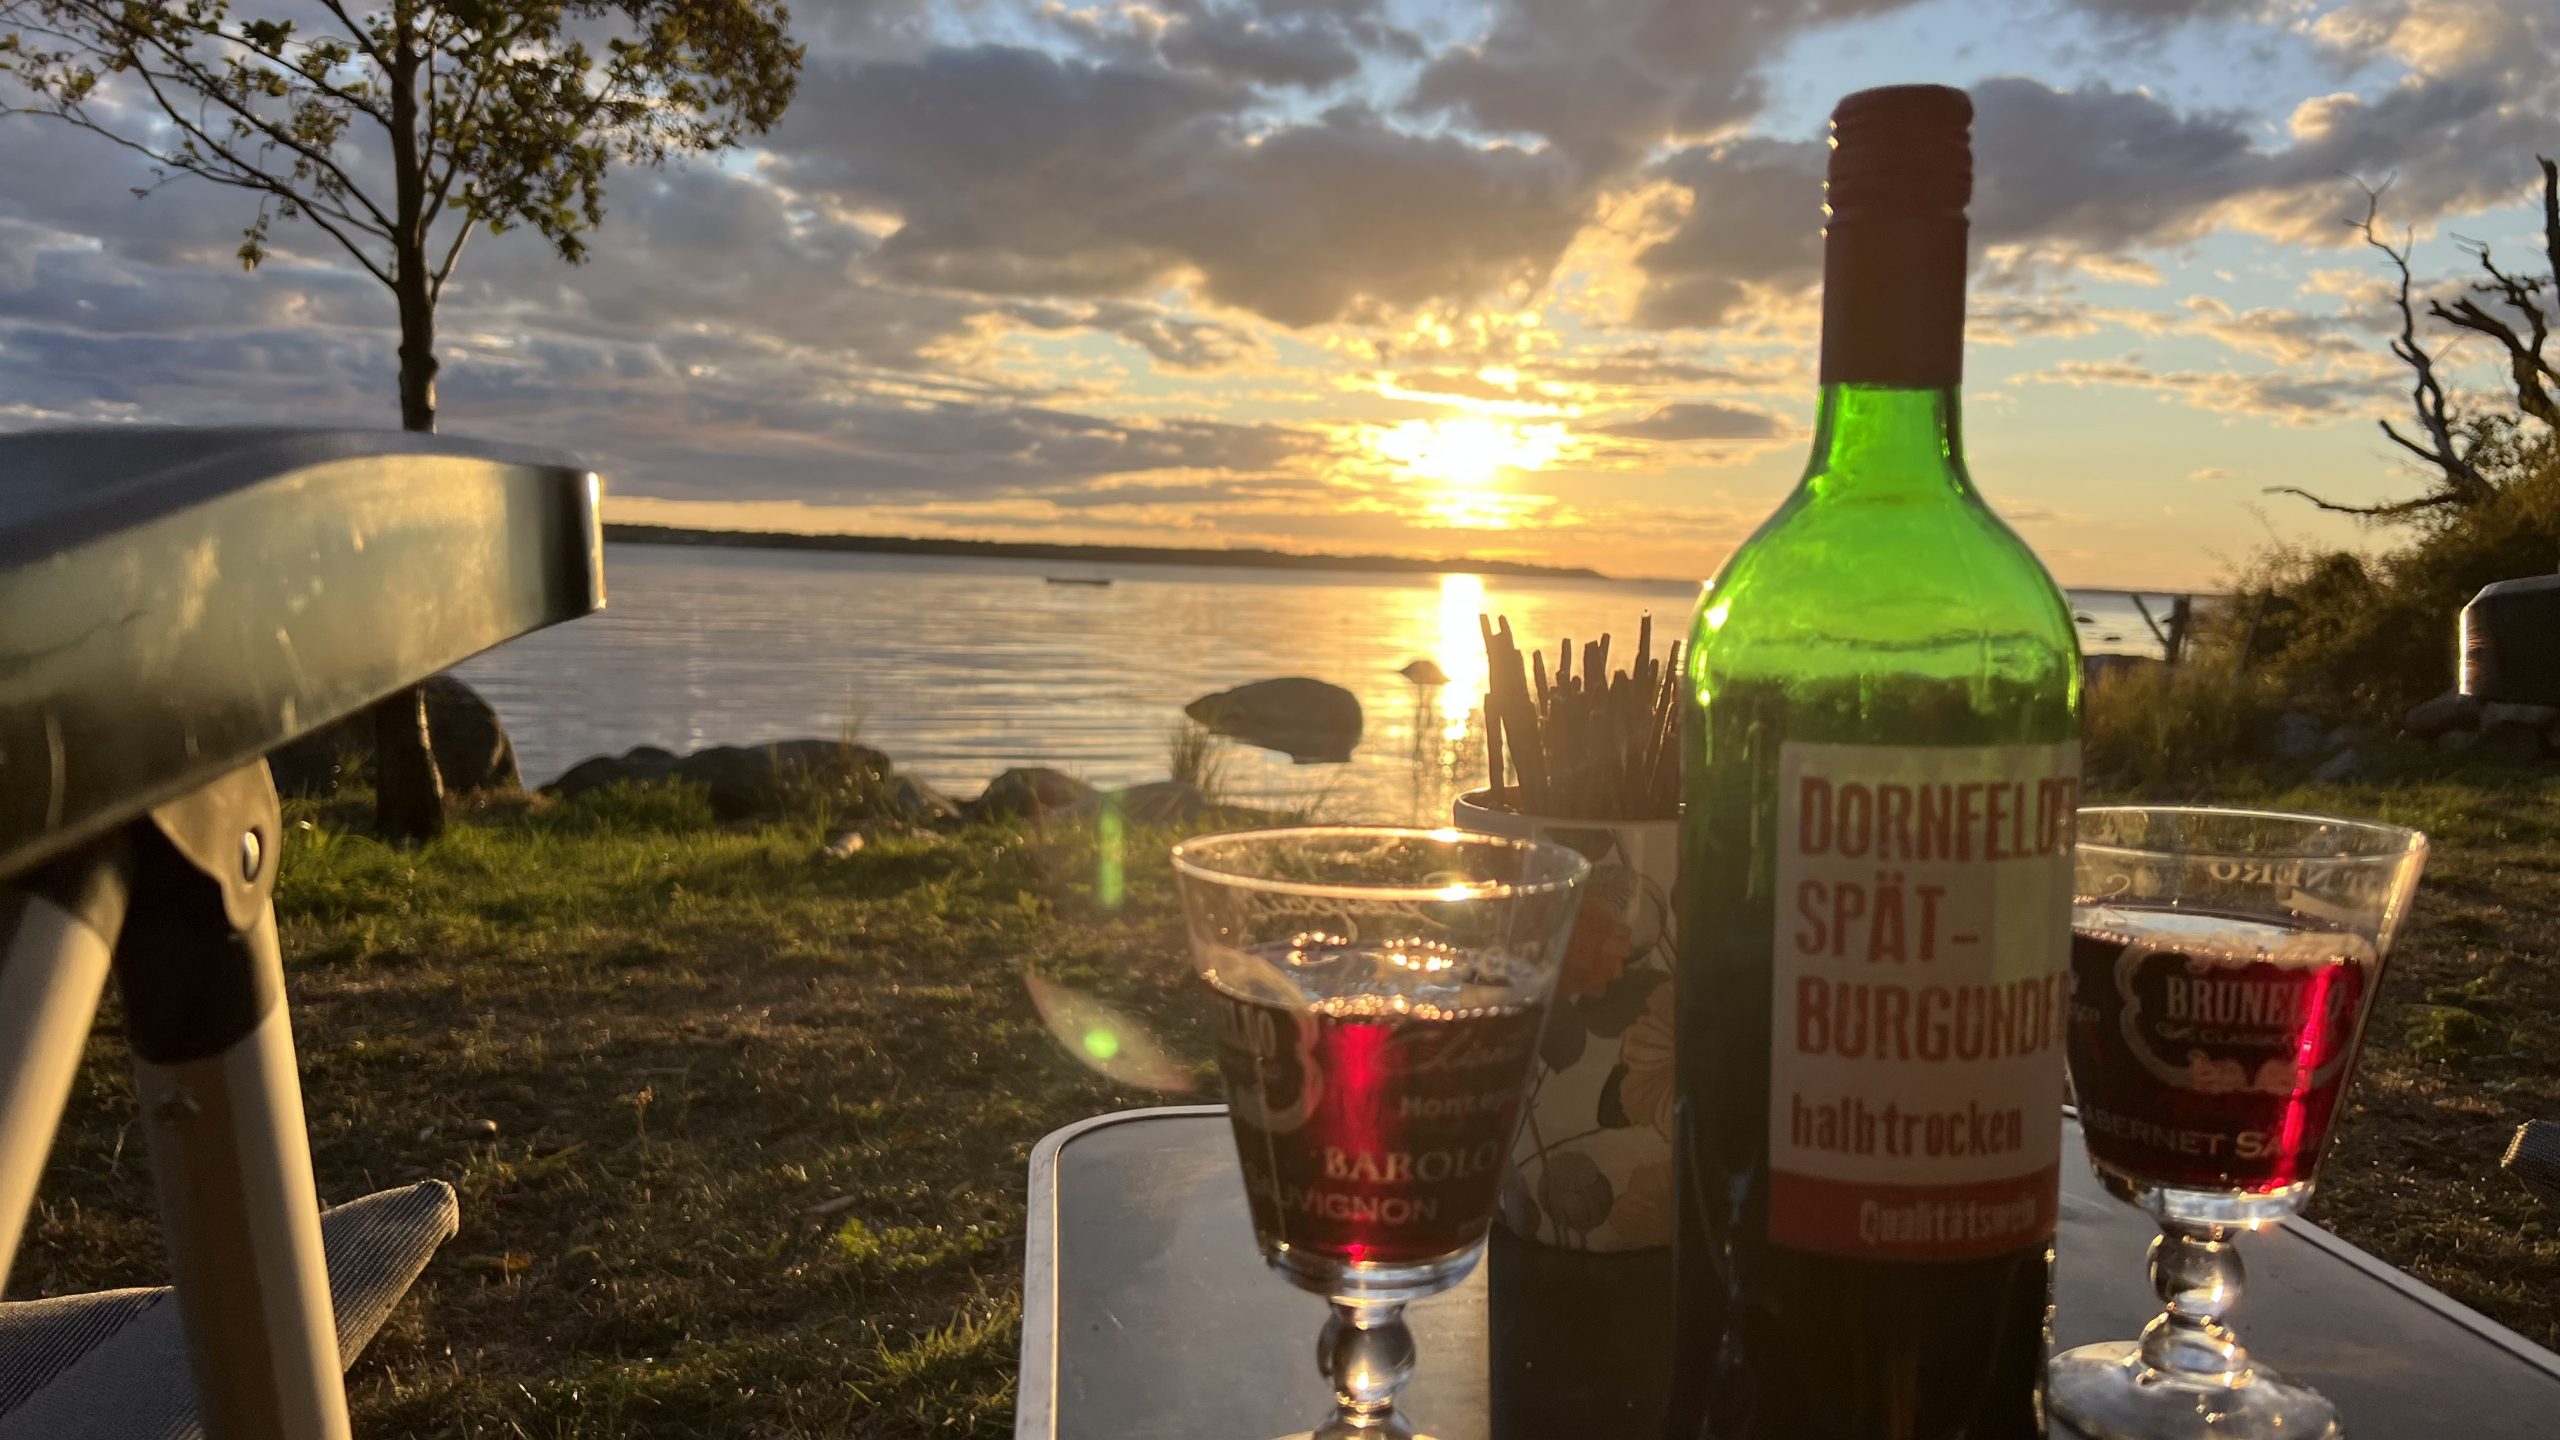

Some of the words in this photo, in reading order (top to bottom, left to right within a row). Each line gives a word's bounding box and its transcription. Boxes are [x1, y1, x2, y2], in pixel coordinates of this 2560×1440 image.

[1795, 871, 1979, 964] SPÄT-
[1791, 1091, 2024, 1157] halbtrocken
[1323, 1141, 1500, 1184] BAROLO
